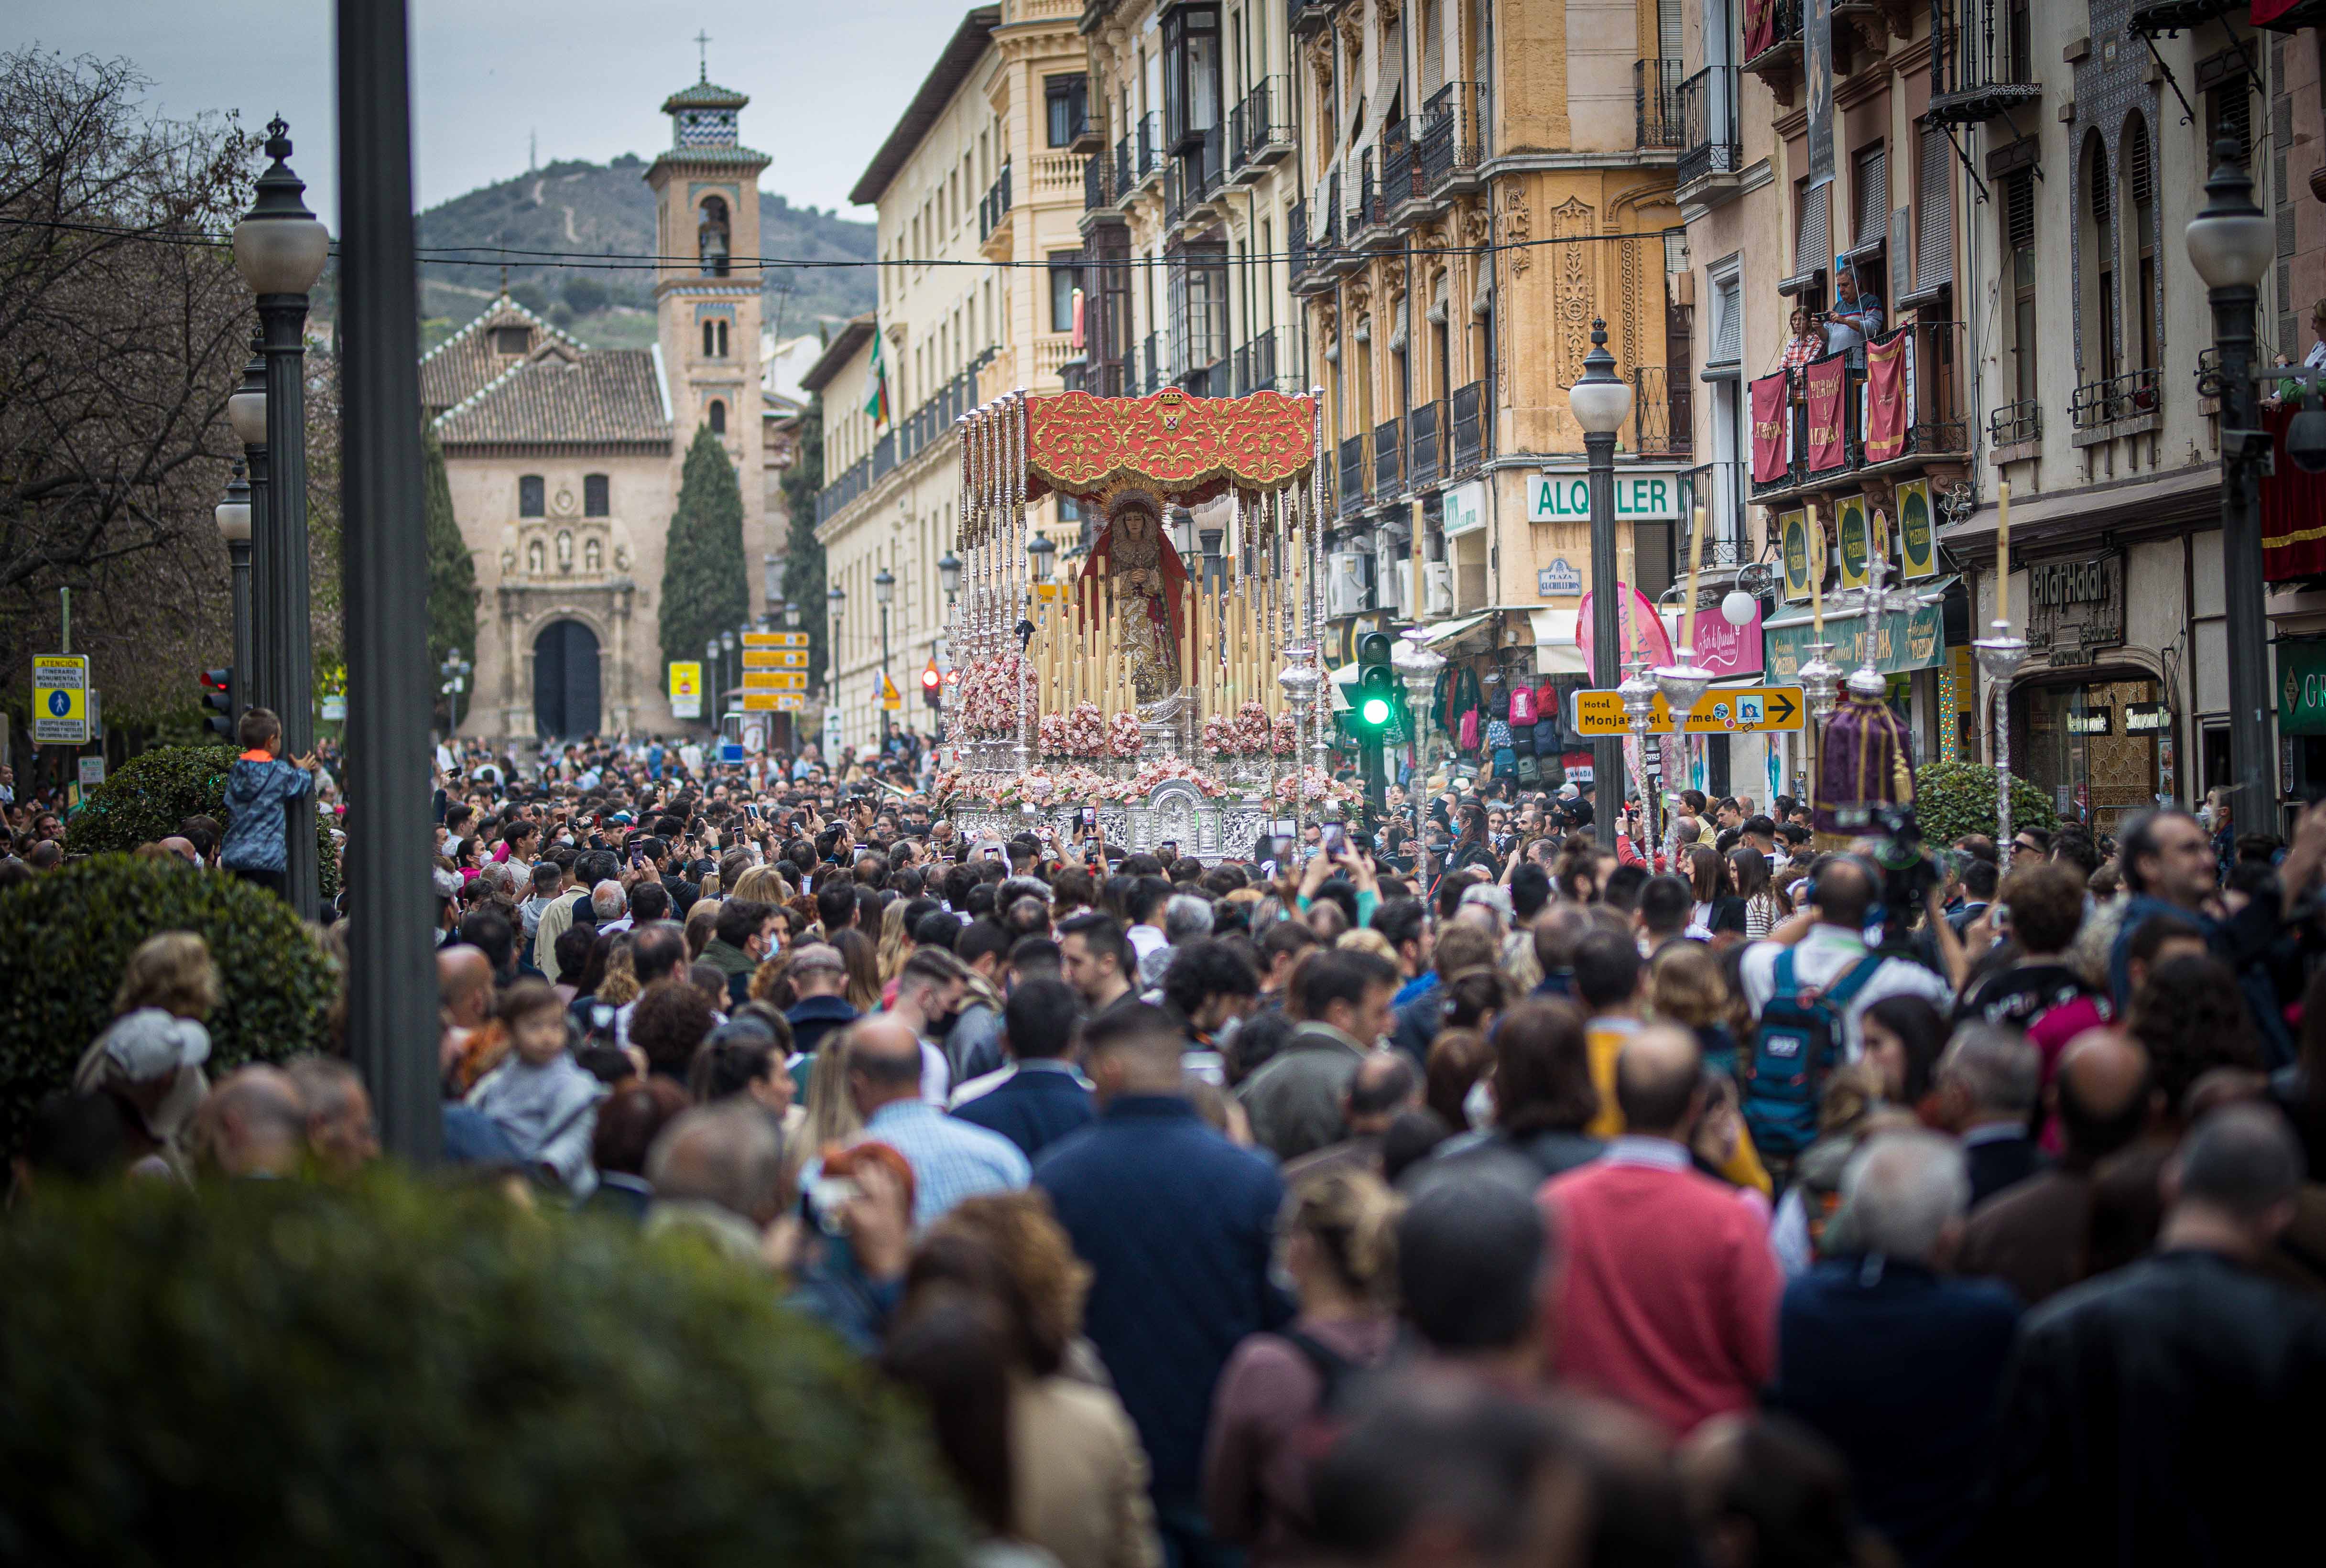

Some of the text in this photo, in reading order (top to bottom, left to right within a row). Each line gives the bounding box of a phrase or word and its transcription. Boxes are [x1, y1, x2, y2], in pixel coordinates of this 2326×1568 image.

[1538, 479, 1667, 515] ALQLER
[1910, 527, 1930, 546] MEDINA
[1584, 699, 1610, 708] Hotel
[1668, 714, 1719, 723] Crmen
